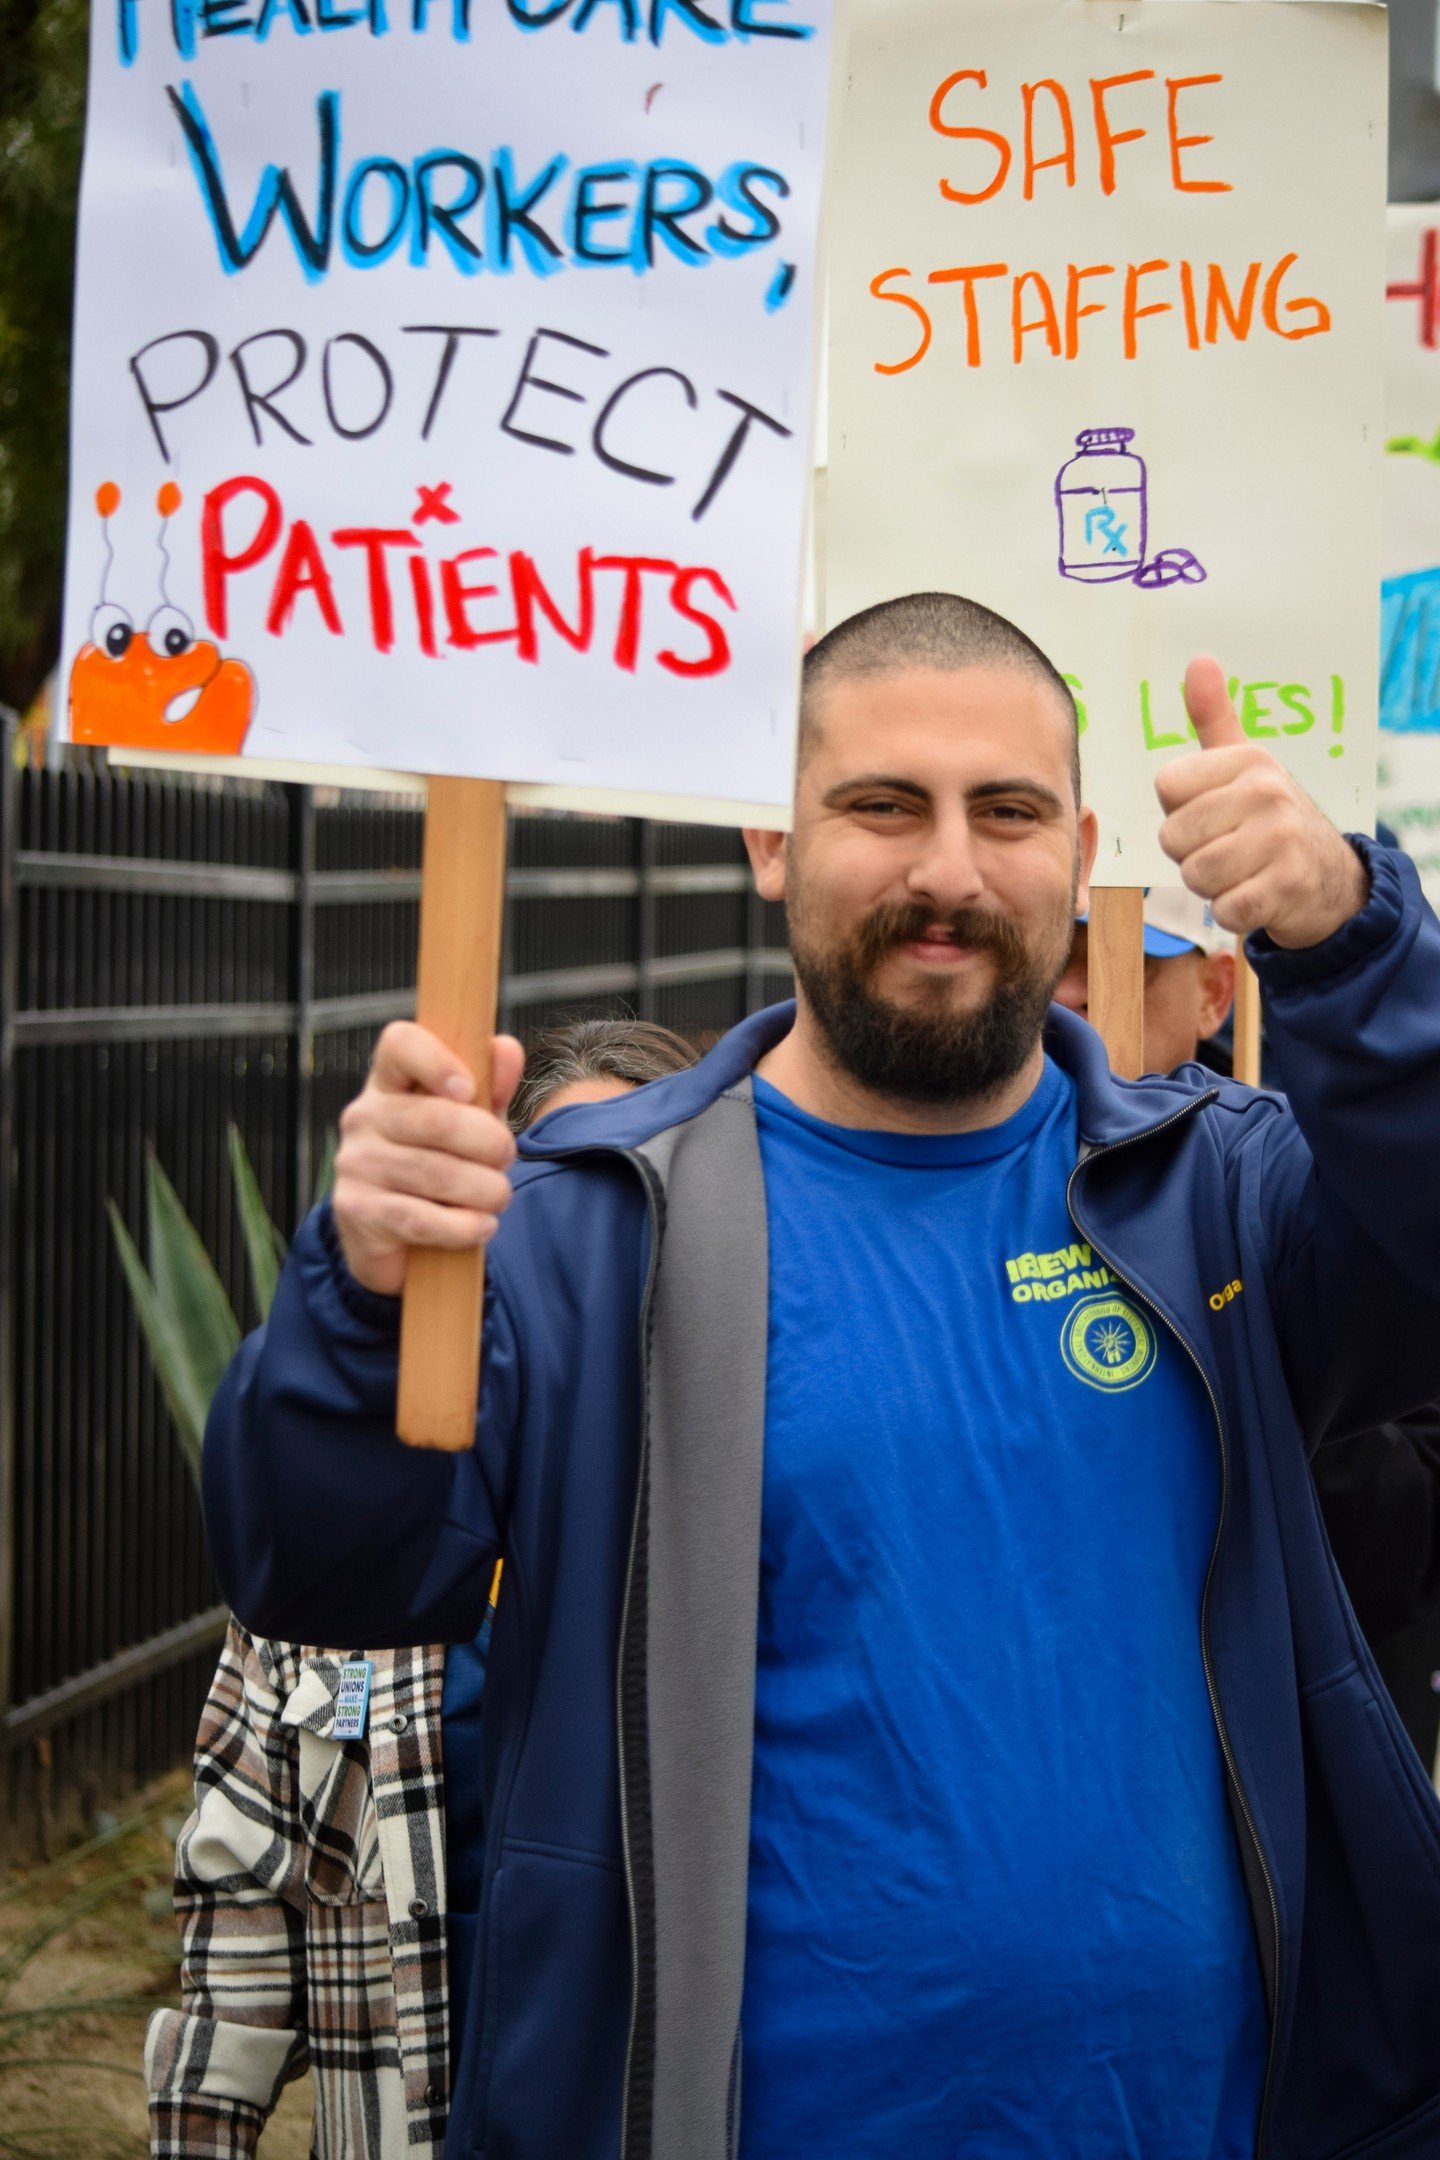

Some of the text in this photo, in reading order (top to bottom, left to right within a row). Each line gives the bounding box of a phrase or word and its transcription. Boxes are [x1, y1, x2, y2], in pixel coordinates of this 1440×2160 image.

[928, 69, 1233, 204] SAFE
[165, 80, 798, 314] WORKERS,
[869, 252, 1331, 375] STAFFING
[129, 327, 792, 522] PROTECT
[1140, 673, 1345, 759] LES!
[1006, 1244, 1092, 1284] IBEW
[340, 1681, 365, 1694] UNIONS
[342, 1668, 367, 1680] STRONG
[336, 1705, 361, 1717] STRONG
[344, 1694, 358, 1704] MAKE
[335, 1718, 360, 1729] PARTNERS
